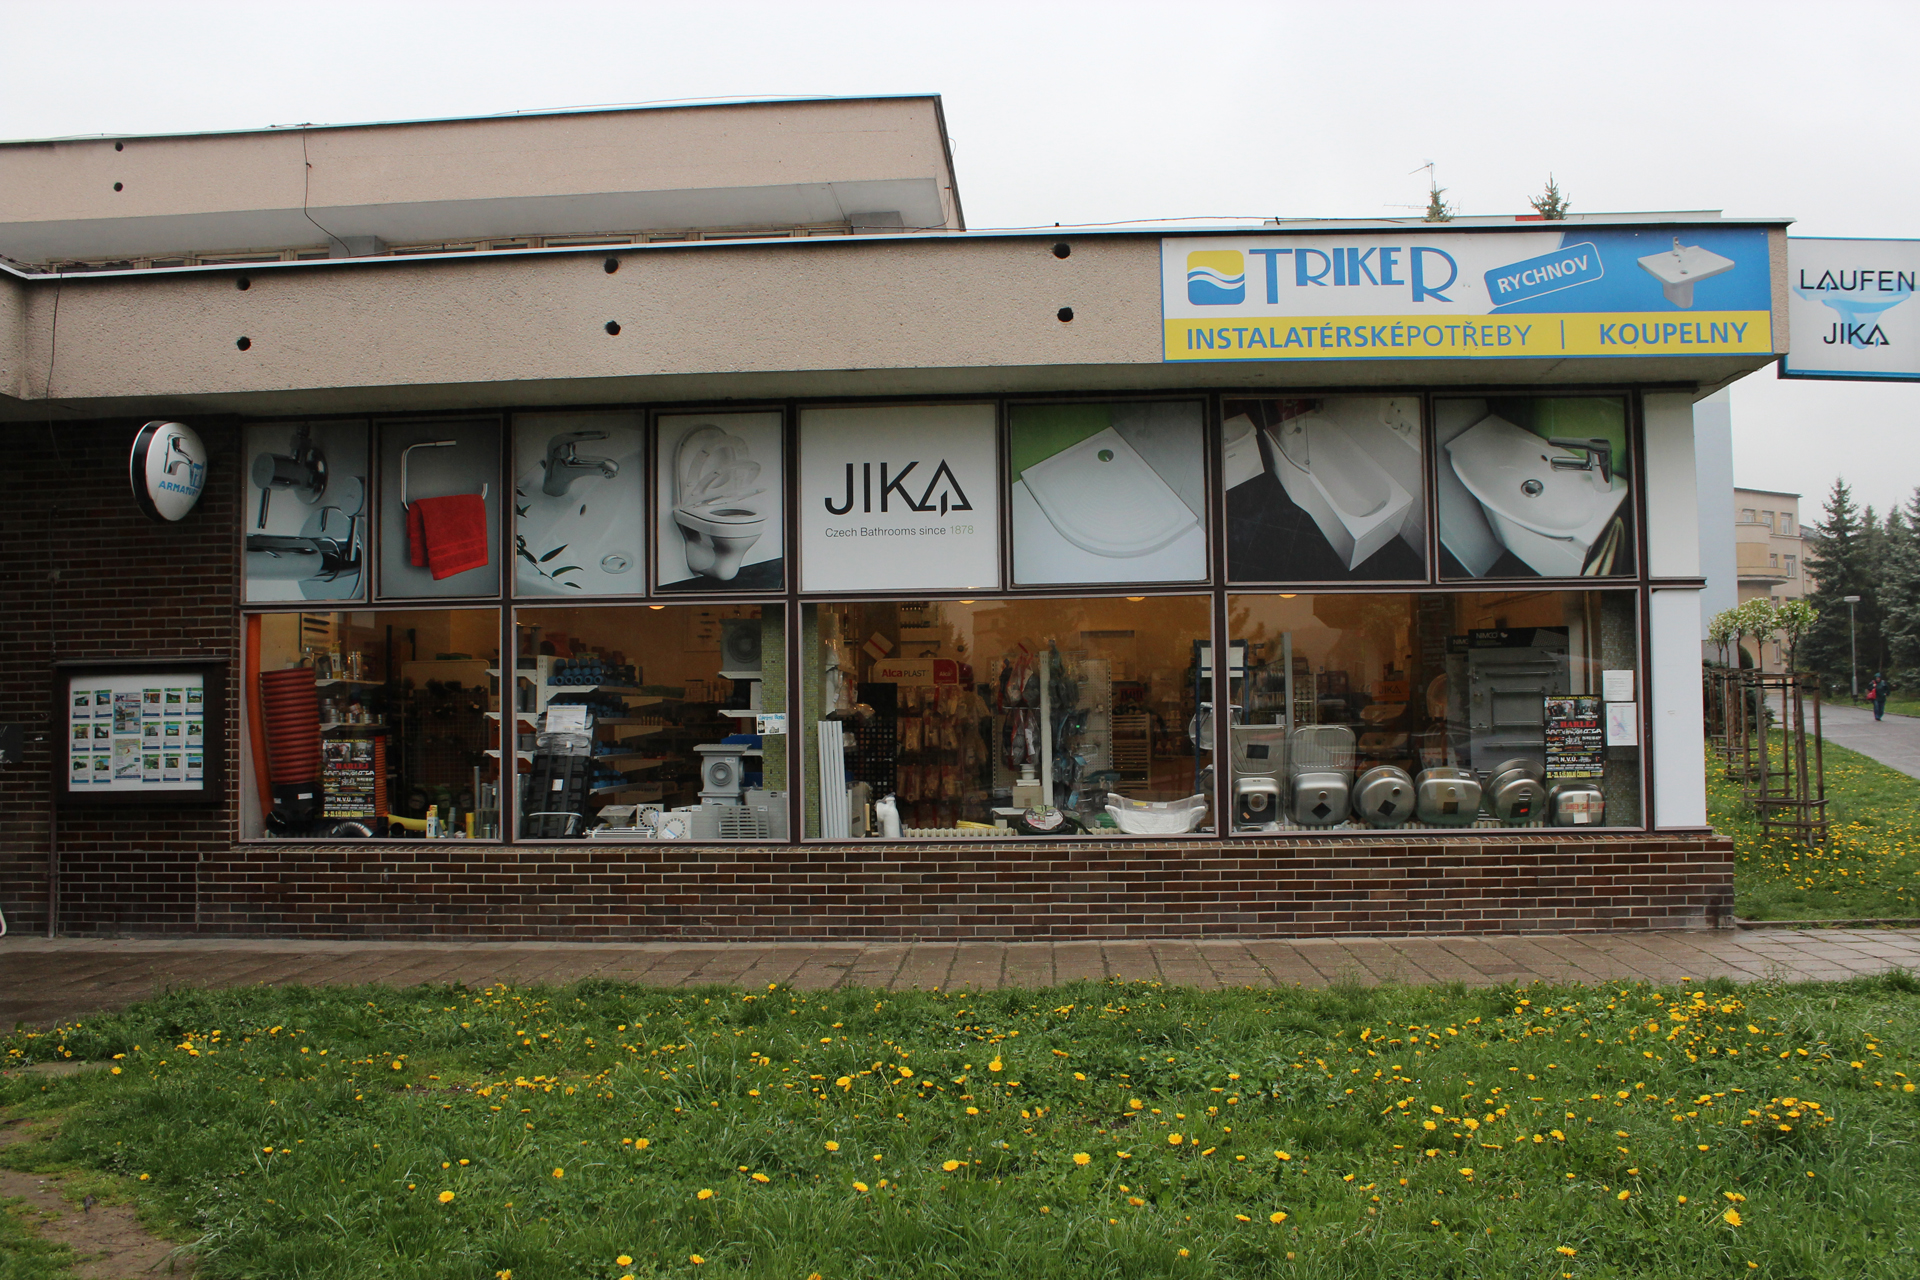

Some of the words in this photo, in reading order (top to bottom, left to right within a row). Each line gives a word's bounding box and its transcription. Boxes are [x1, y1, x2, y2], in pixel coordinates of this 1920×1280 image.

[1248, 246, 1458, 304] TRIKER
[1497, 254, 1588, 294] RYCHNOV
[1800, 269, 1915, 292] LAUFEN
[1599, 321, 1749, 345] KOUPELNY
[1823, 322, 1890, 347] JIKA
[824, 458, 973, 517] JIKA
[825, 527, 858, 538] Czech
[860, 526, 917, 537] Bathrooms
[918, 525, 947, 535] since
[949, 525, 974, 535] 1878
